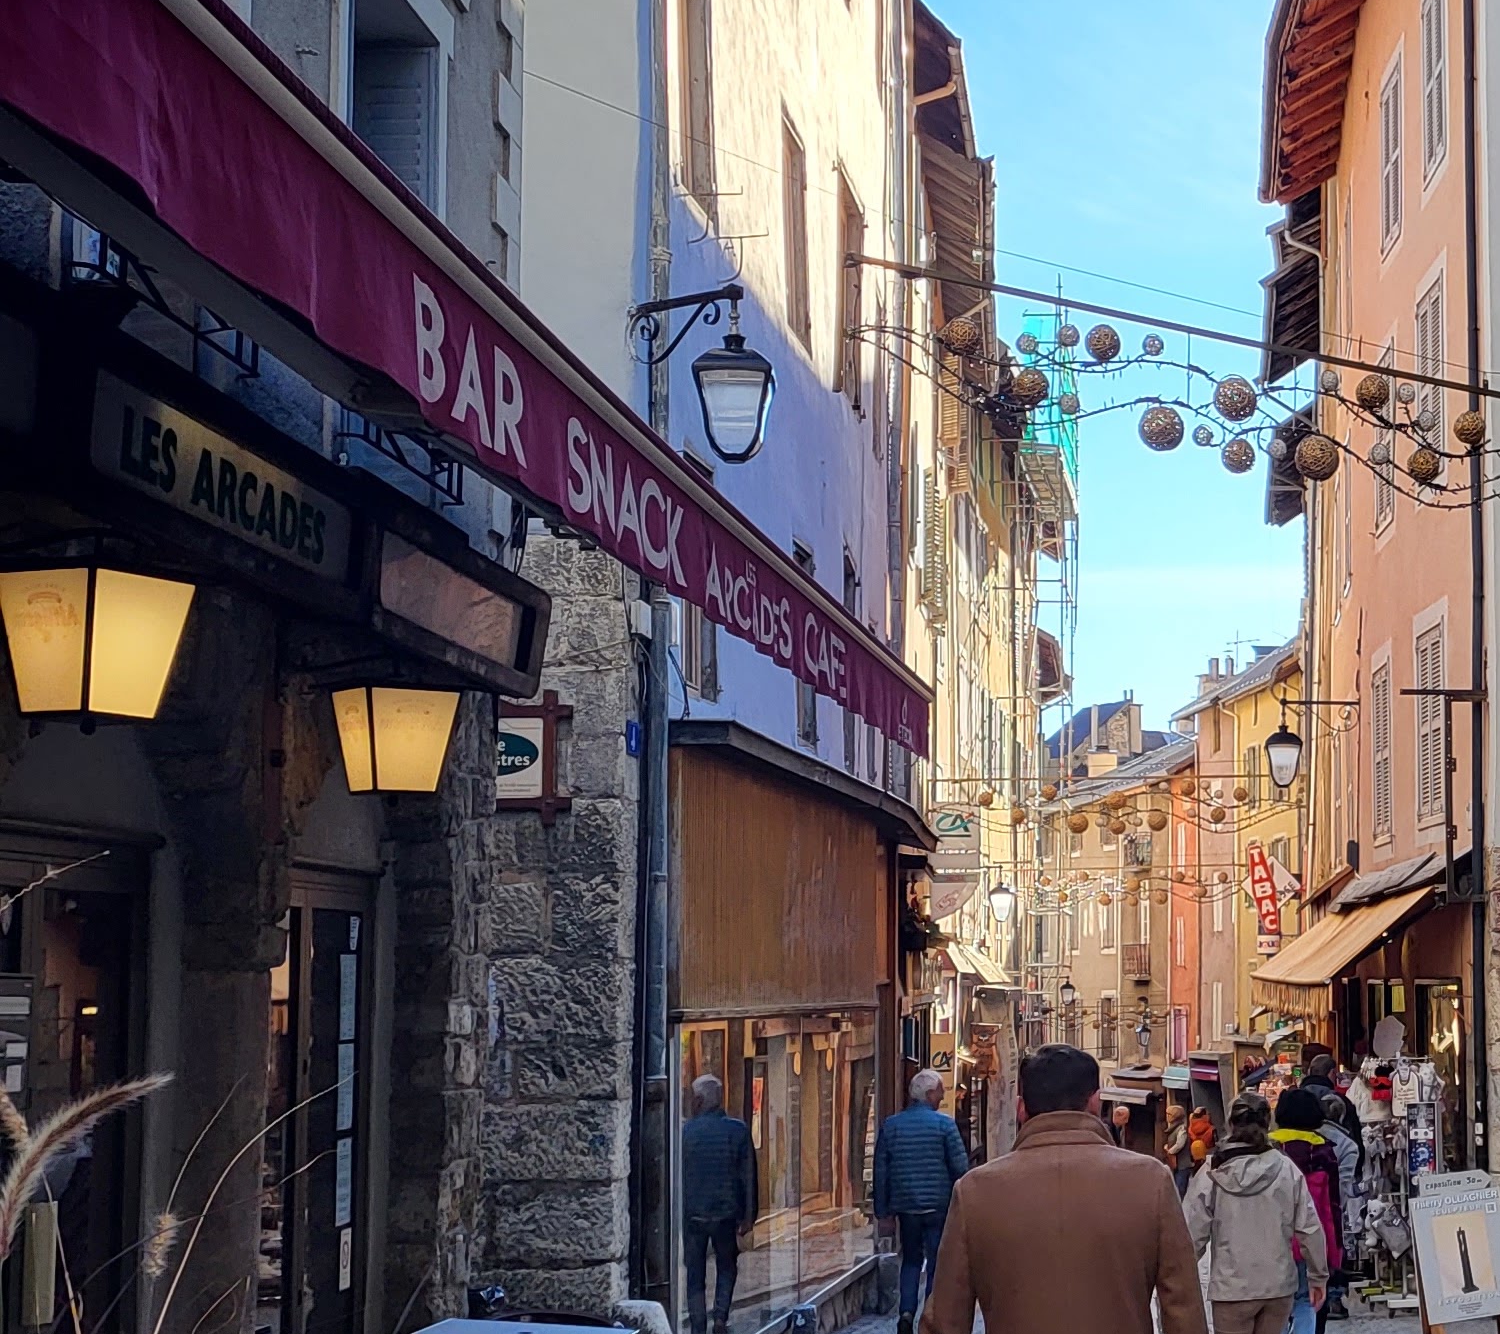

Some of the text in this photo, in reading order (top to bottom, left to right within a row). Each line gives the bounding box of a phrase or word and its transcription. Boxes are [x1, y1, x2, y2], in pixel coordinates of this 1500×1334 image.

[120, 404, 327, 565] LES ARCADES
[413, 271, 688, 588] BAR SNACK
[1249, 848, 1278, 930] TABAC
[1412, 1190, 1499, 1210] Thierry OLLAGNIER
